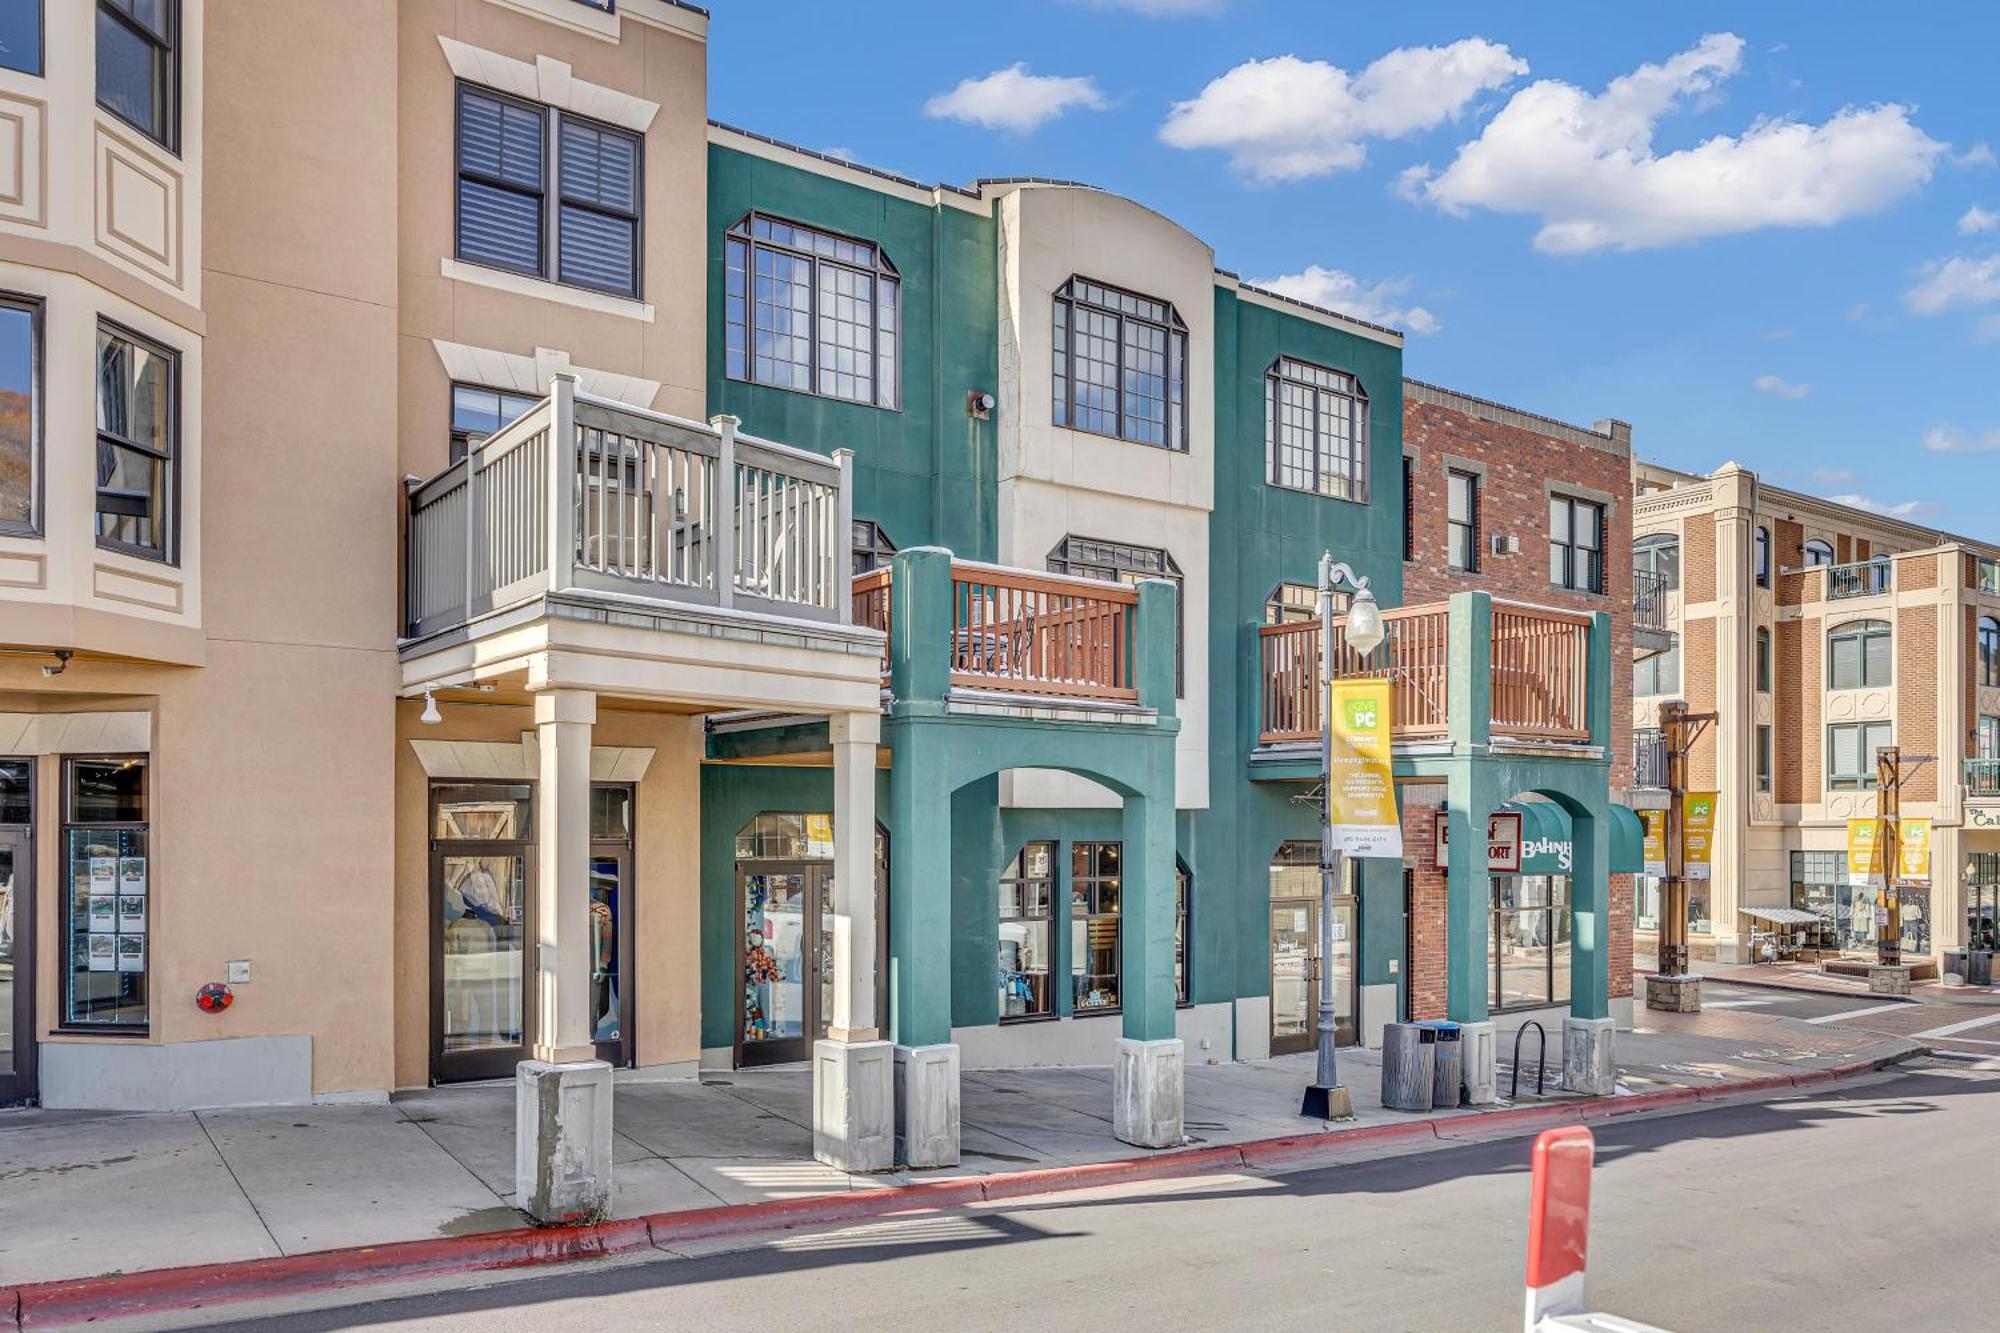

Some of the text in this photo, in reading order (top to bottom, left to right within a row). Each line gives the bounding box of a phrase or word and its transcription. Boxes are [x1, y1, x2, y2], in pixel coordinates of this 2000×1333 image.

[1355, 712, 1376, 728] PC
[1488, 846, 1511, 859] ORT
[1521, 837, 1572, 858] BAHNH
